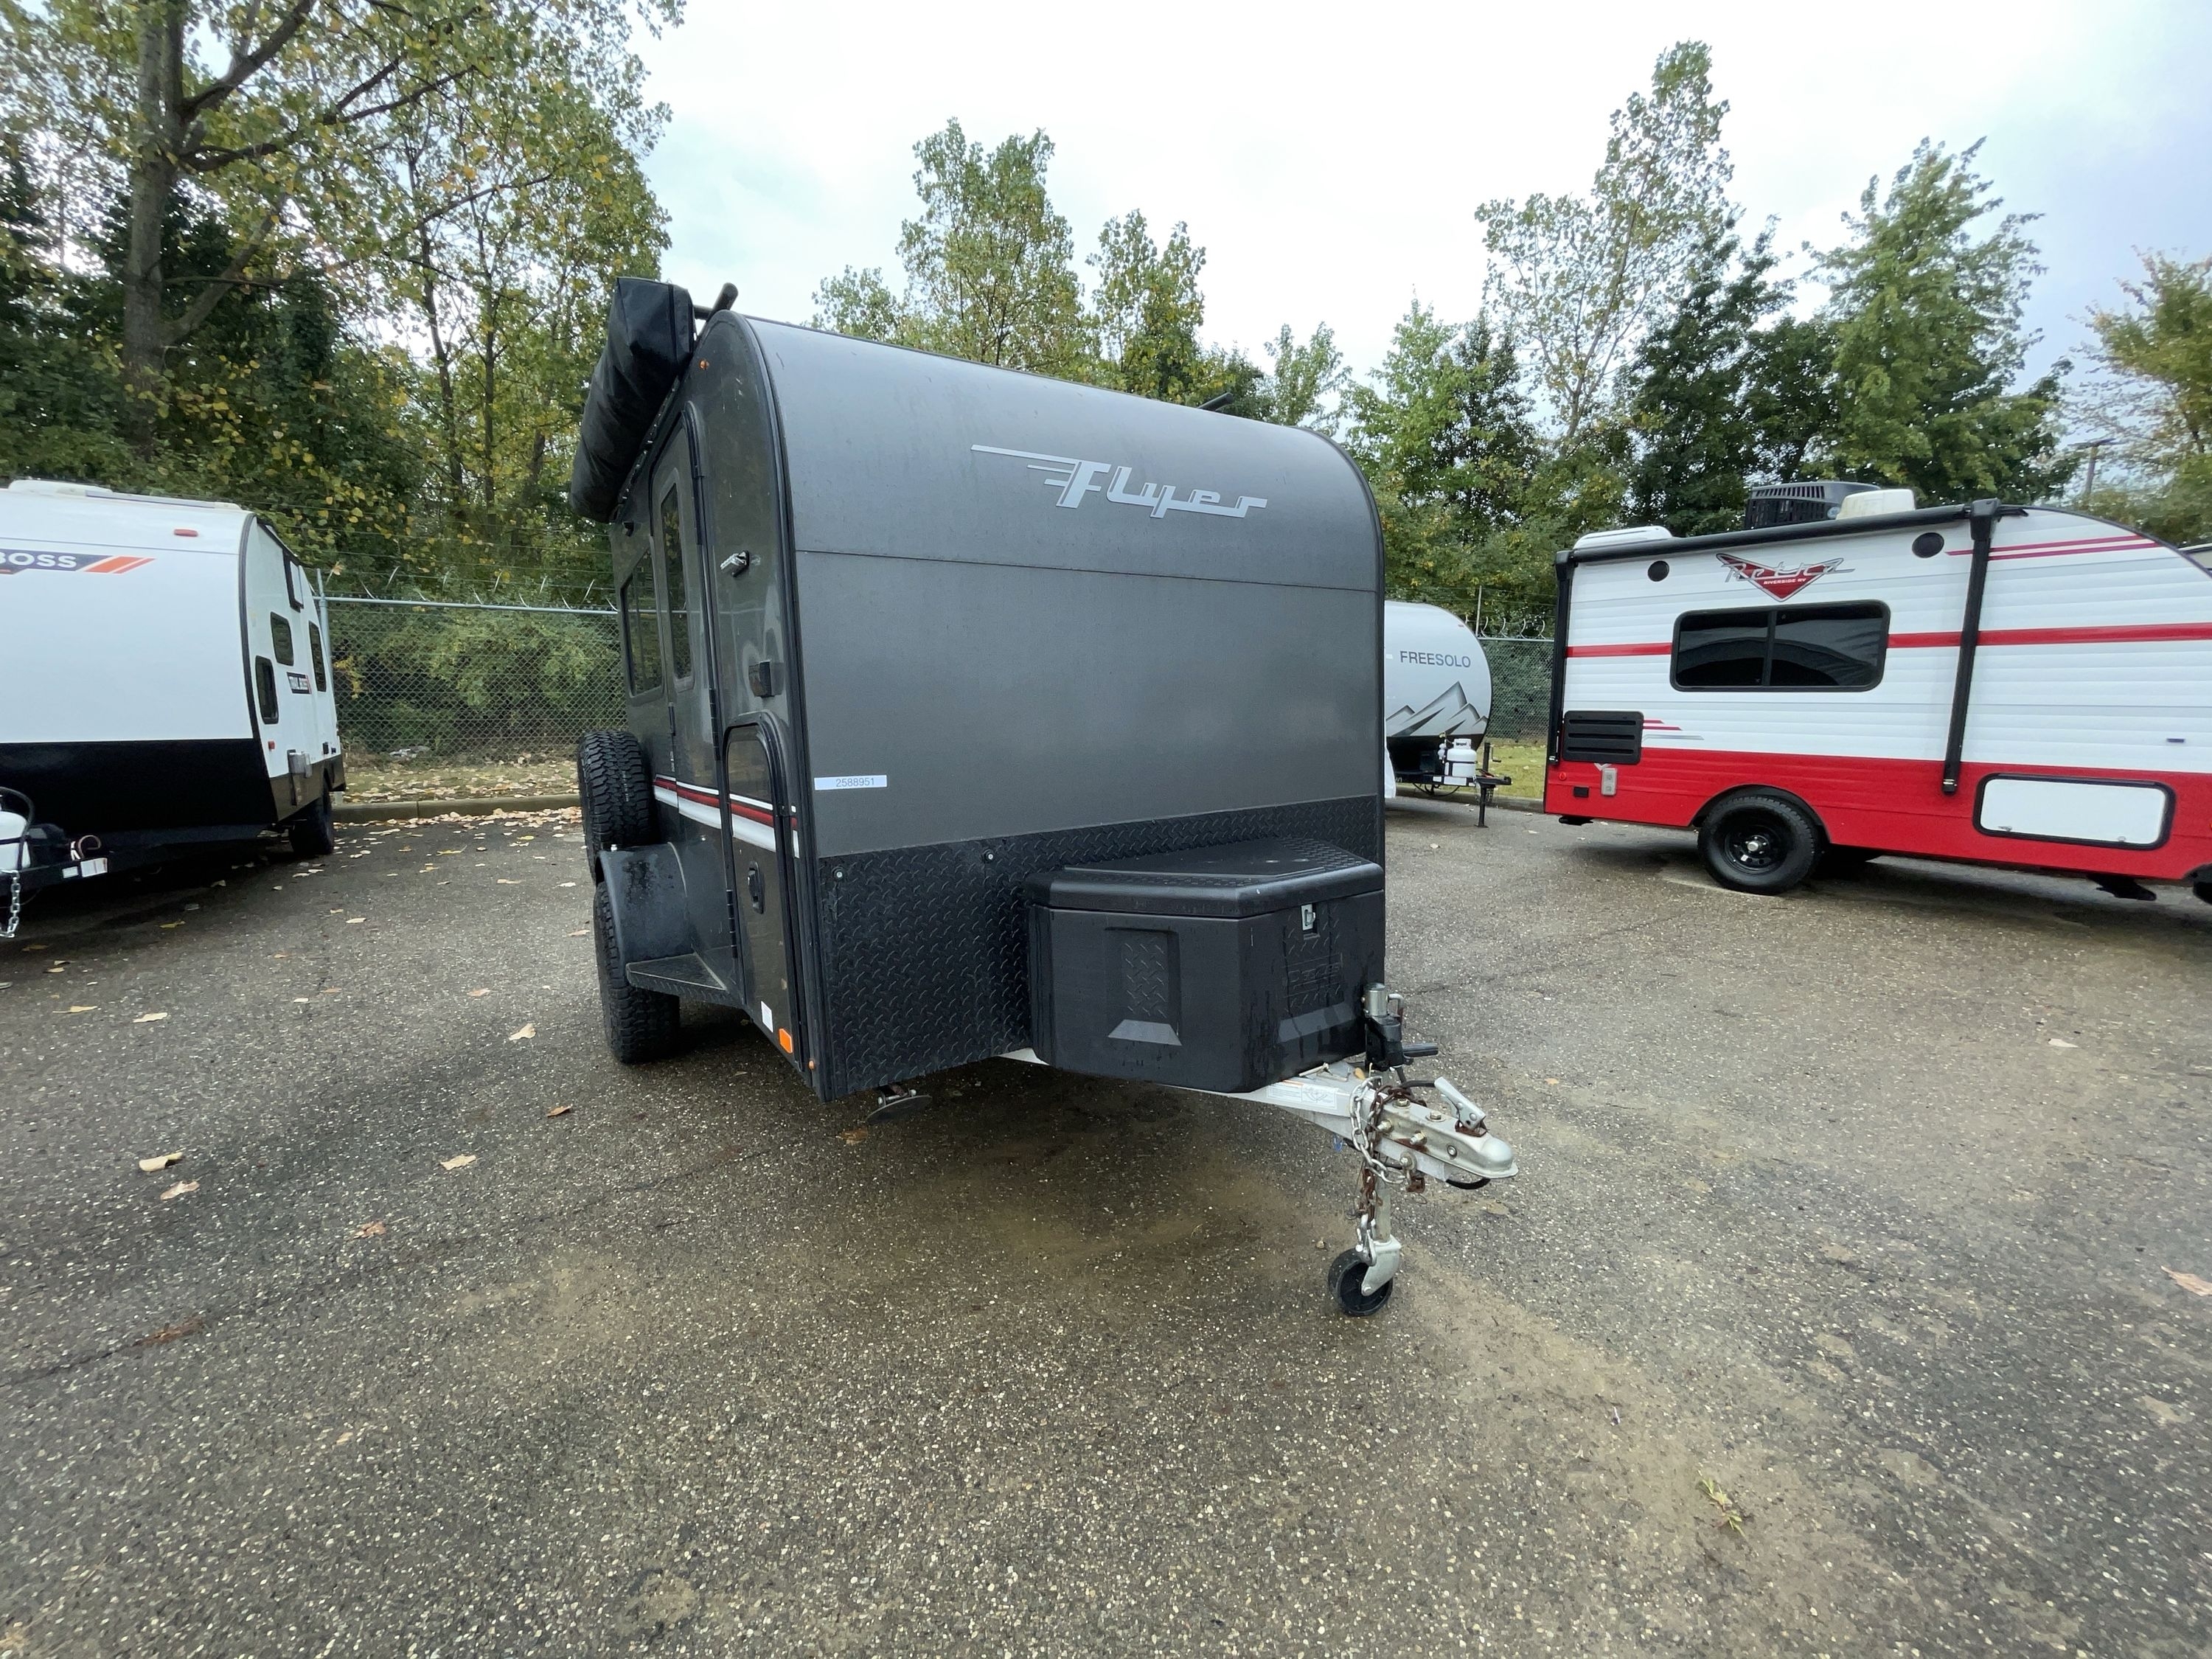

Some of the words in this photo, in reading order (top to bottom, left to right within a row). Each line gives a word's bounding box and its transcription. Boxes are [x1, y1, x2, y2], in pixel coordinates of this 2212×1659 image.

[970, 445, 1268, 518] Flyer
[0, 552, 77, 568] OSS
[1399, 650, 1471, 668] FREESOLO
[835, 778, 874, 787] 2588951
